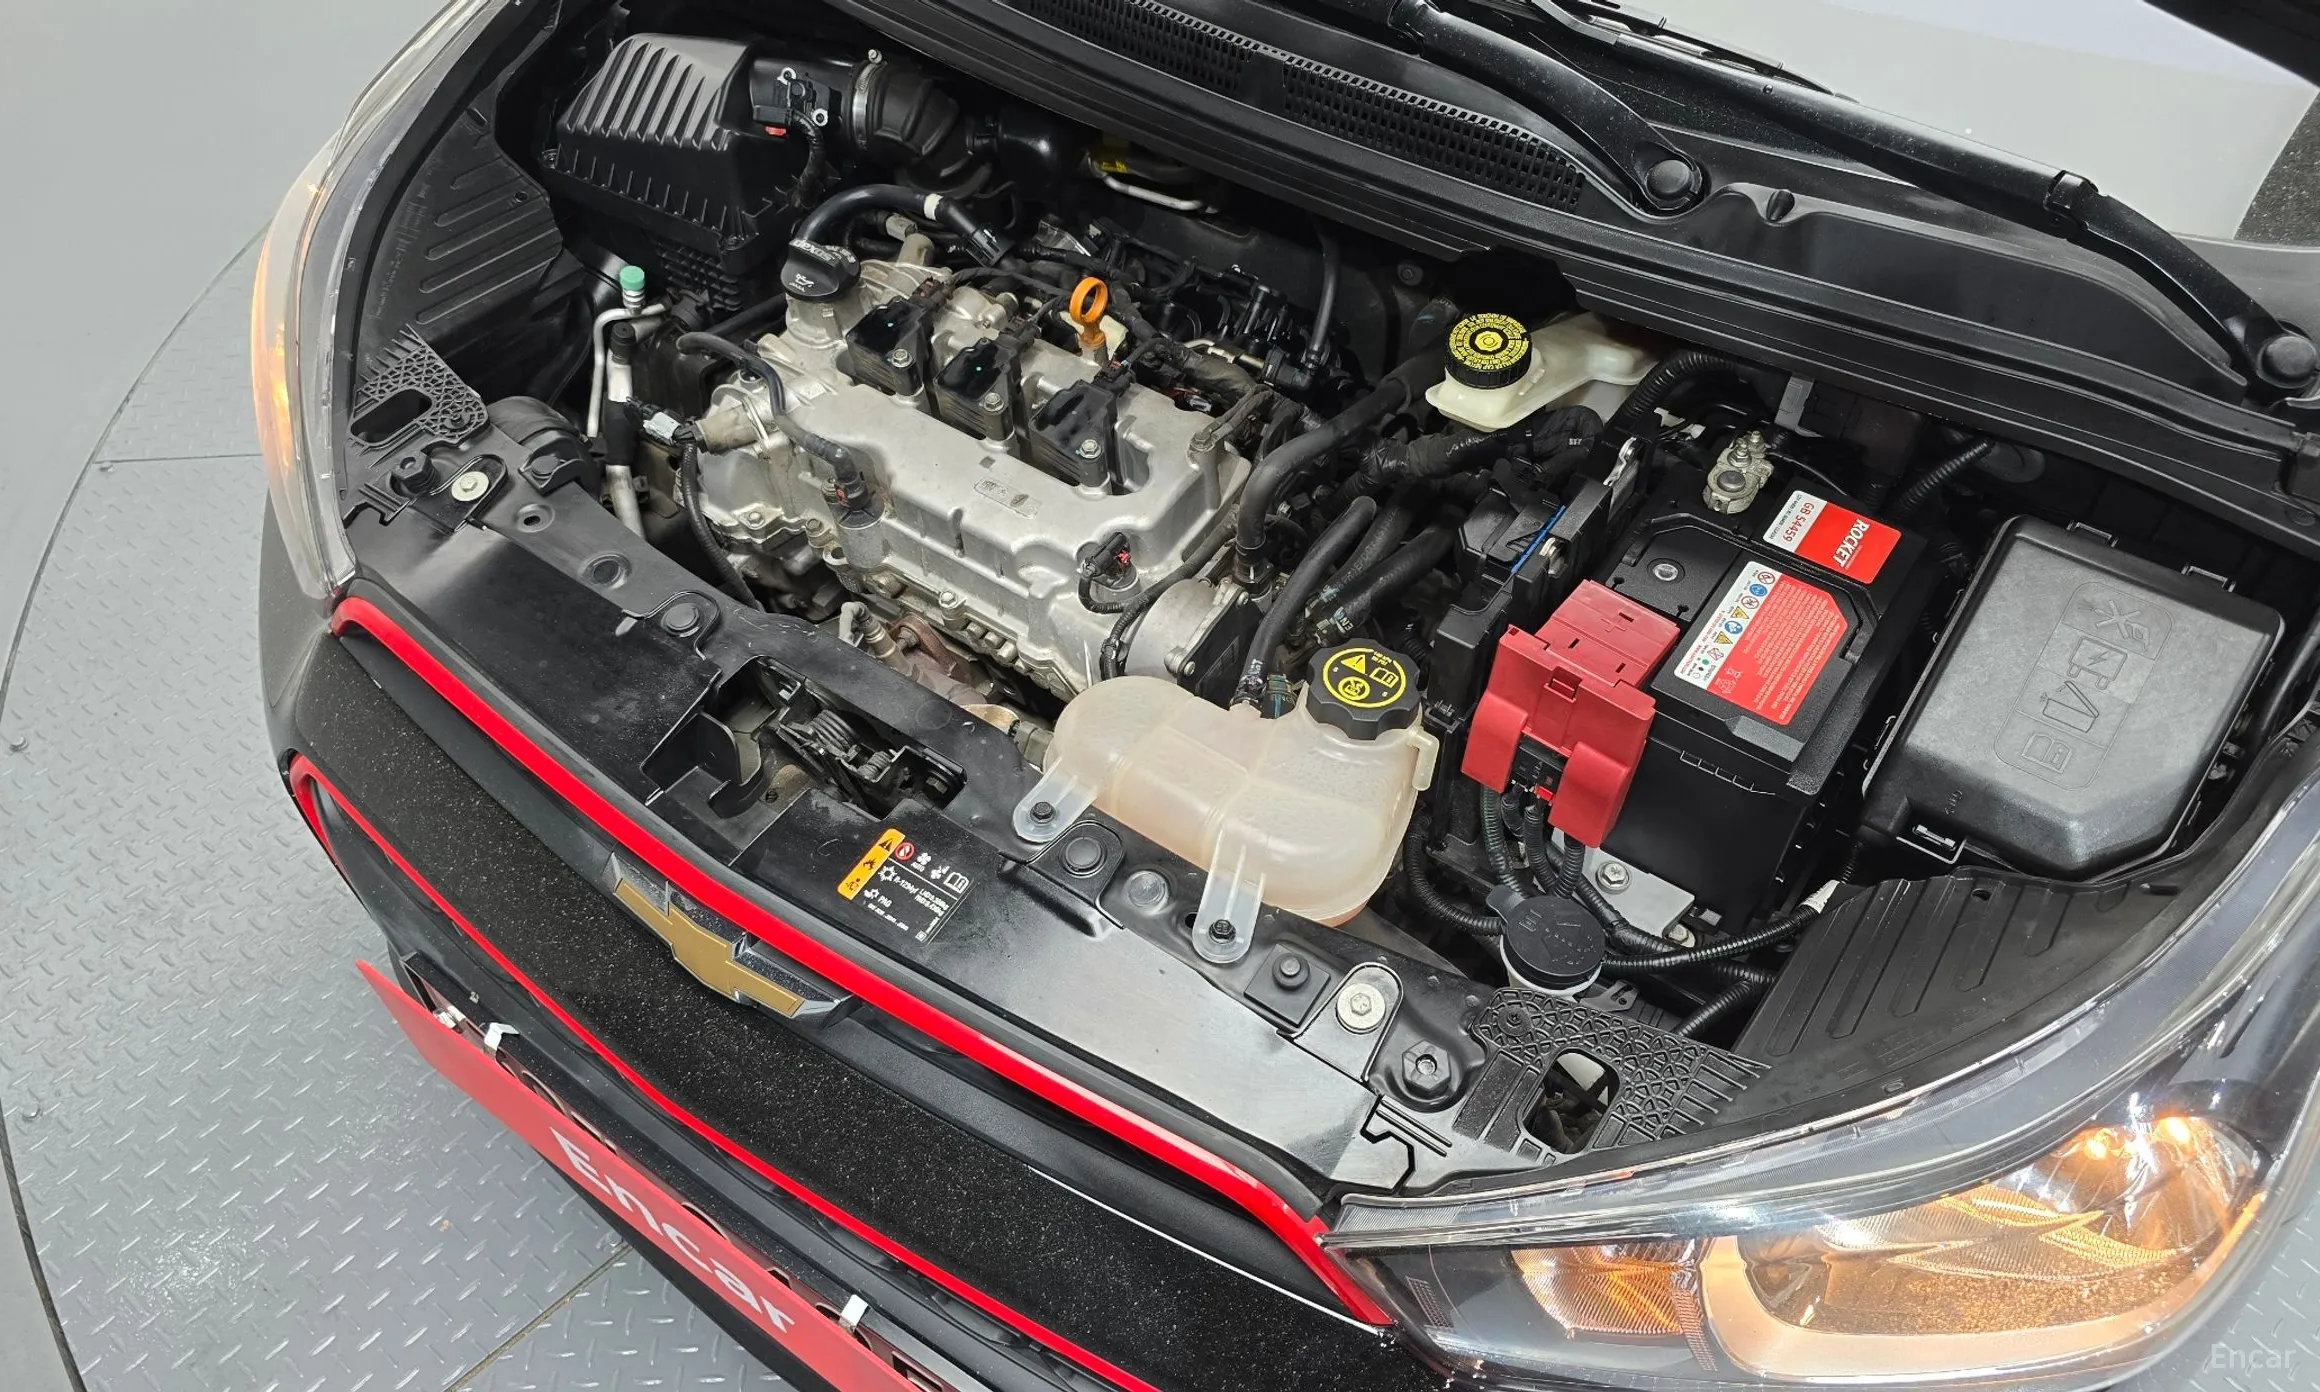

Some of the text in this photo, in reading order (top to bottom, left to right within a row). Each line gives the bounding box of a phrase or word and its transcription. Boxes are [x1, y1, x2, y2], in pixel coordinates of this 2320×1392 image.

[793, 239, 835, 262] dexos
[1803, 502, 1815, 519] GB
[1782, 516, 1809, 543] 54459
[1832, 519, 1870, 568] ROCKET
[549, 1126, 796, 1334] Encar
